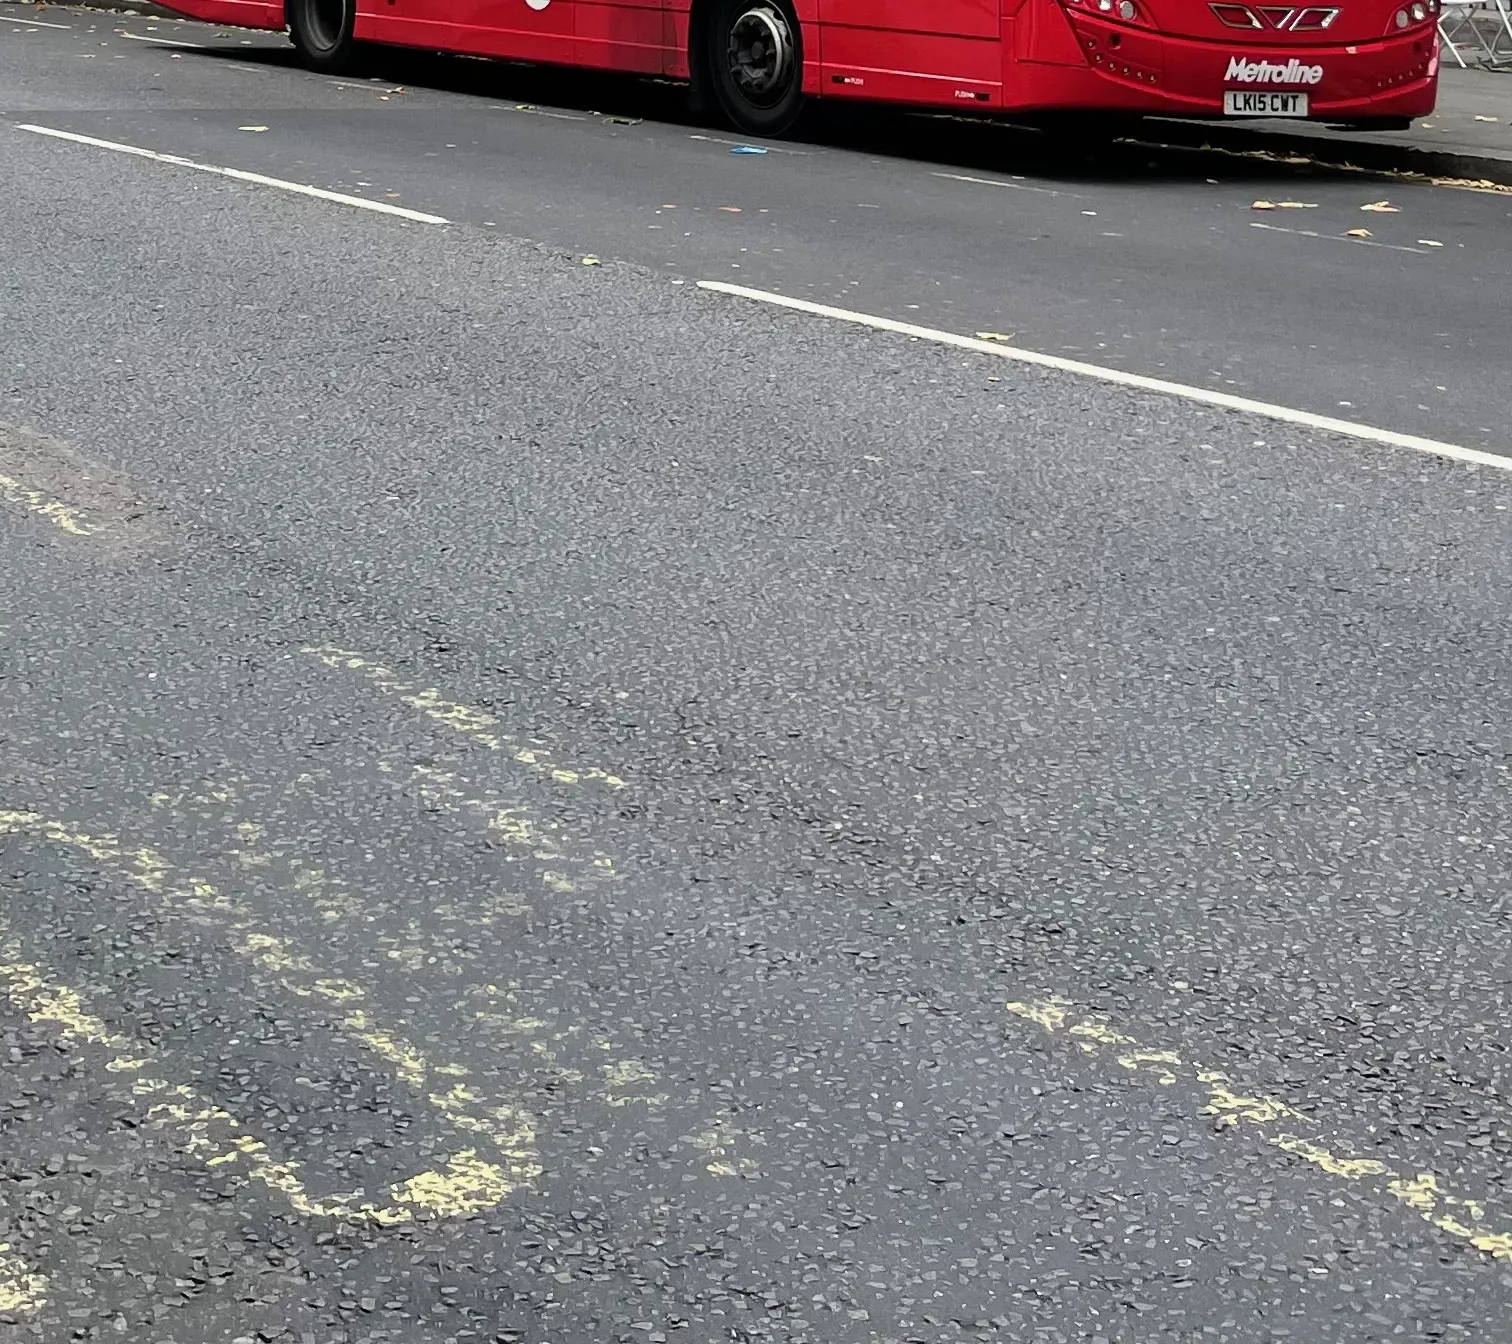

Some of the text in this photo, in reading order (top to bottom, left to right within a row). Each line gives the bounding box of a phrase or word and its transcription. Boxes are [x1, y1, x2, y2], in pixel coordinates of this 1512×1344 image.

[1224, 56, 1323, 84] Metroline
[1233, 93, 1299, 112] LK15 CWT
